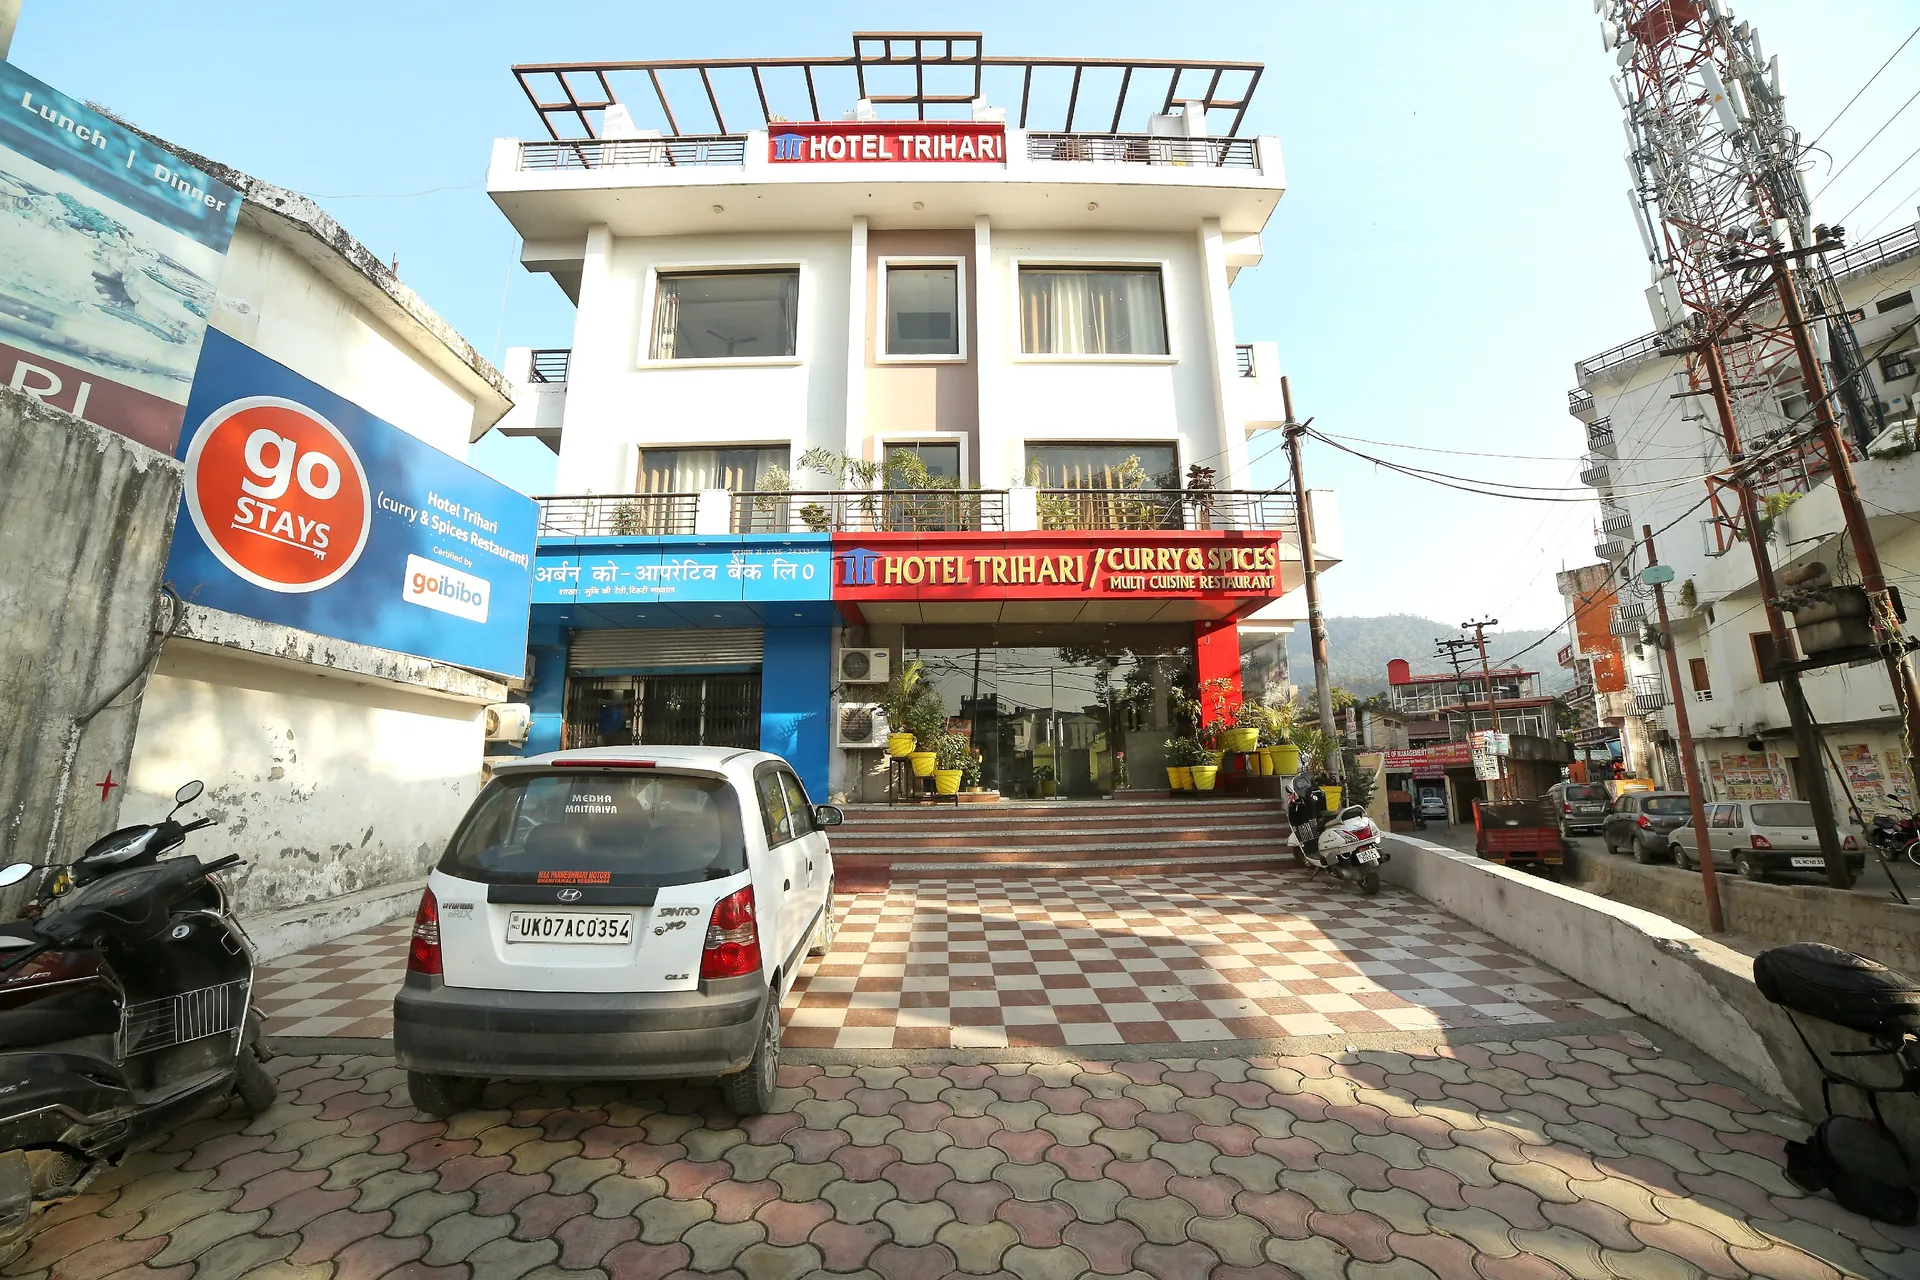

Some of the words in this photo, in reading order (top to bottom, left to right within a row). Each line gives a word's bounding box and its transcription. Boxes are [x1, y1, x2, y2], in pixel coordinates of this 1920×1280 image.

[21, 91, 107, 150] Lunch
[153, 163, 226, 212] Dinner
[809, 135, 892, 159] HOTEL
[899, 135, 1002, 159] TRIHARI
[241, 428, 341, 500] go
[234, 496, 331, 549] STAYS
[427, 491, 460, 519] Hotel
[462, 507, 498, 534] Trihari
[377, 491, 418, 523] (curry
[420, 510, 429, 526] &
[431, 515, 468, 542] Spices
[470, 532, 529, 571] Restaurant)
[433, 546, 463, 564] Certified
[463, 558, 473, 568] by
[1107, 547, 1184, 571] CURRY
[1207, 547, 1276, 571] SPICES
[884, 555, 970, 584] HOTEL
[973, 555, 1084, 583] TRIHARI
[412, 573, 482, 607] goibibo
[1110, 575, 1145, 590] MULTI
[1149, 575, 1196, 589] CUISINE
[1200, 575, 1276, 589] RESTAURANT
[565, 804, 617, 814] MAITRAIYA
[572, 794, 612, 803] MEDHA
[657, 906, 700, 918] SANTRO
[520, 916, 630, 938] UK07AC0354
